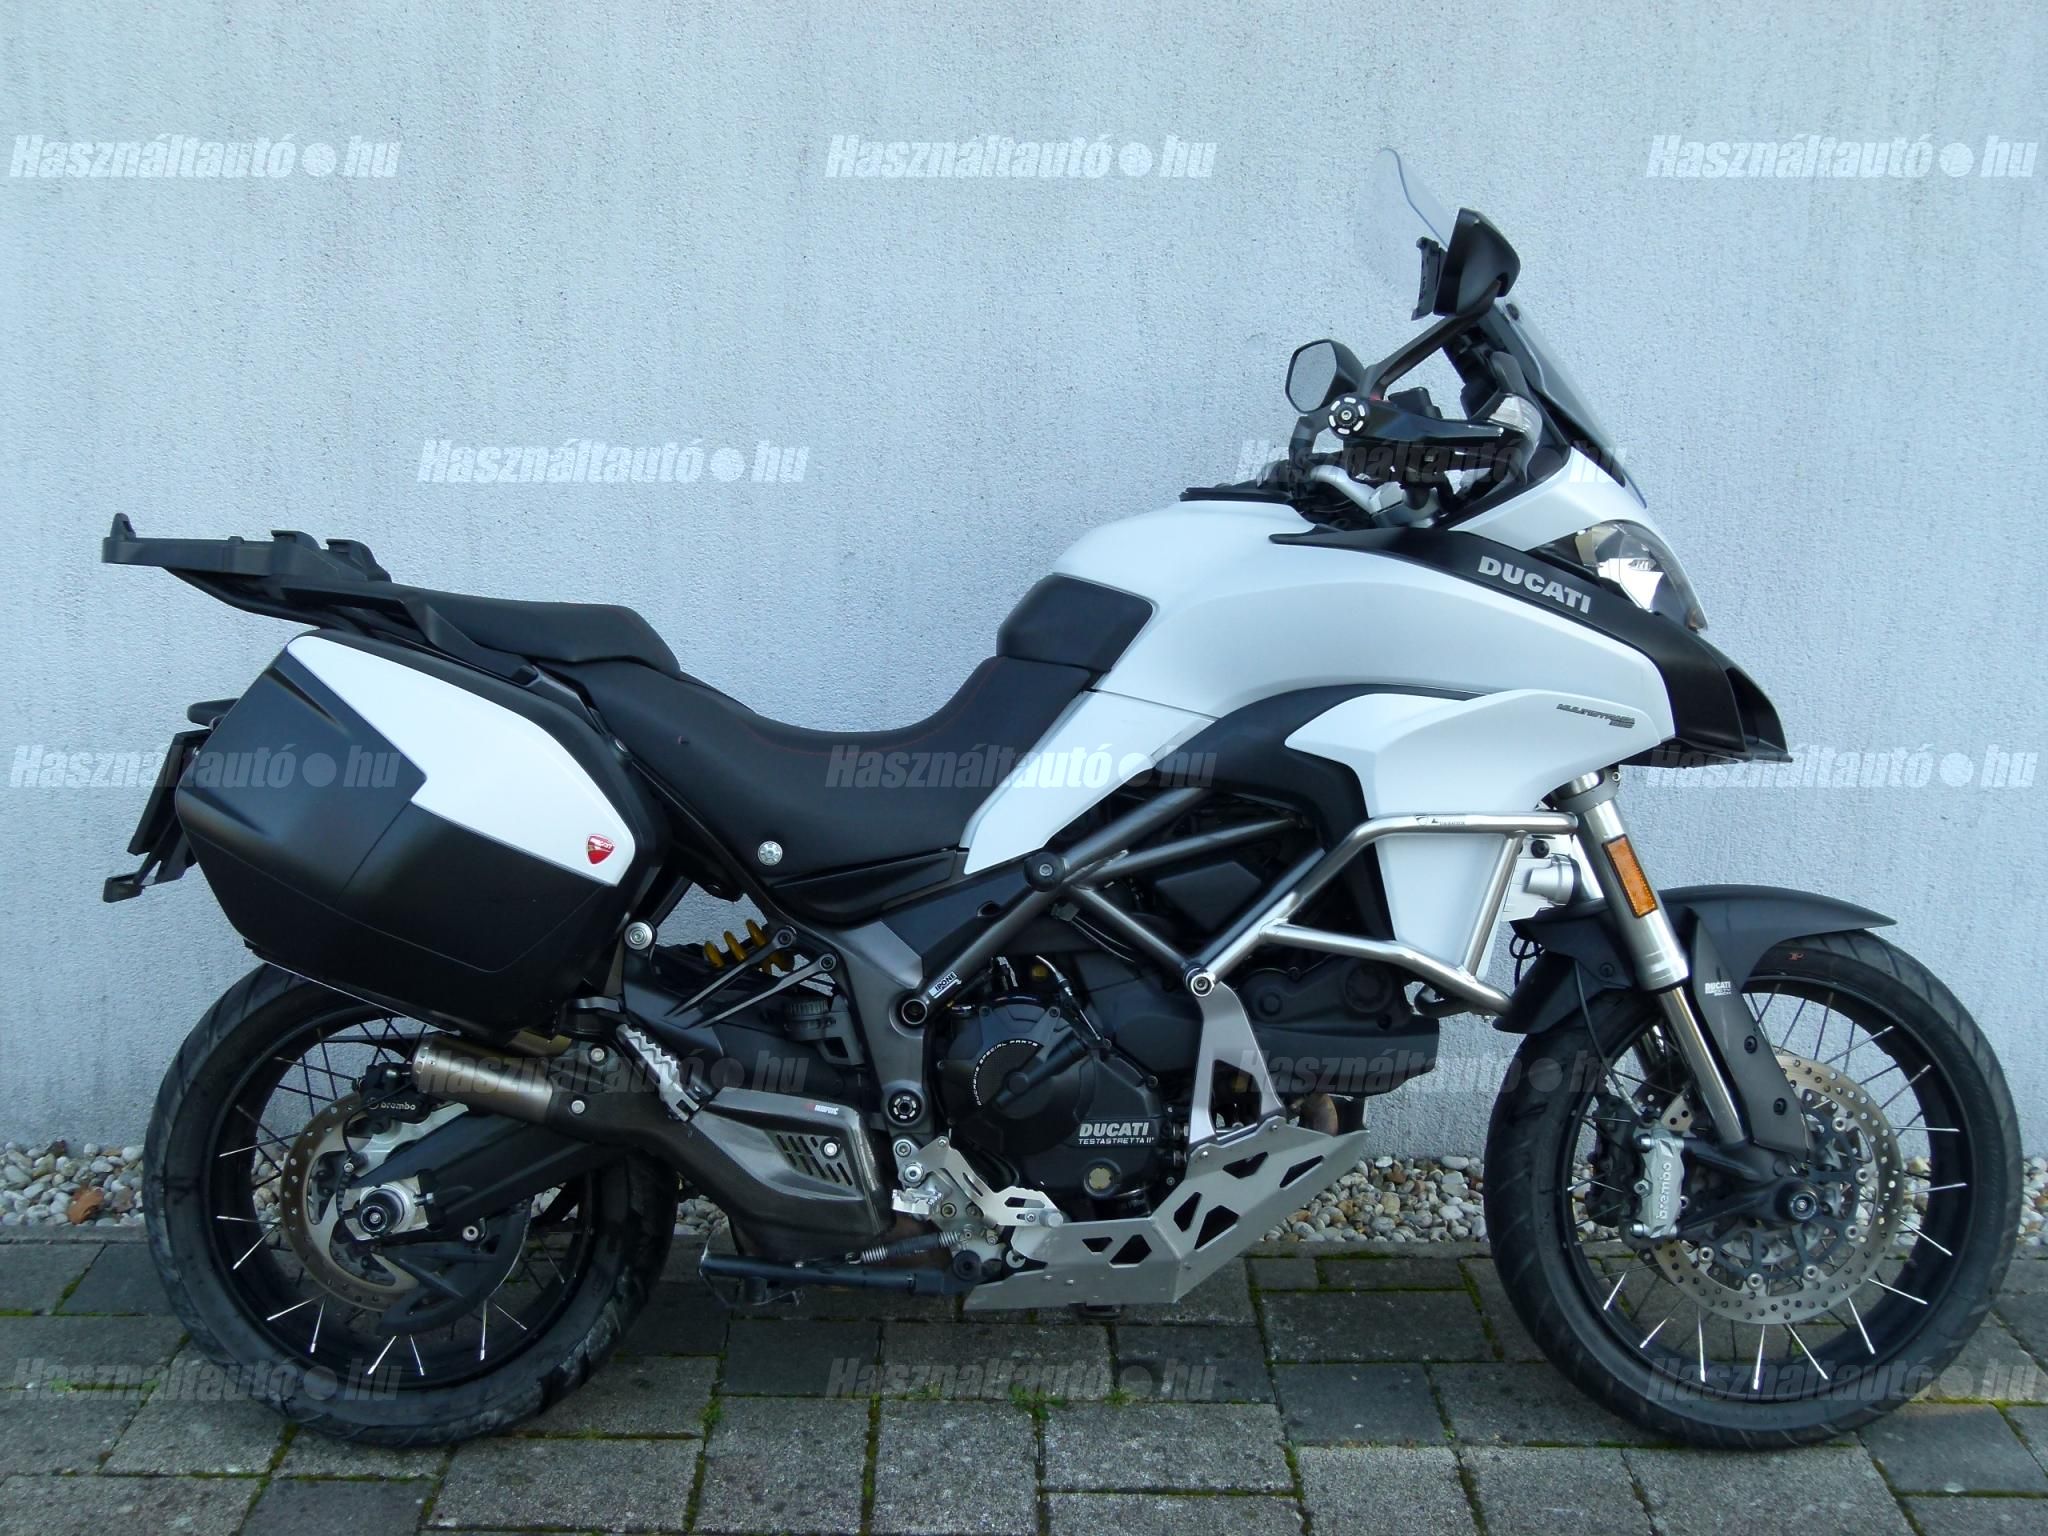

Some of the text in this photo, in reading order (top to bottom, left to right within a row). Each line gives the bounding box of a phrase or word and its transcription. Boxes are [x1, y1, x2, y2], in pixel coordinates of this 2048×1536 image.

[1478, 555, 1591, 614] DUCATI
[934, 972, 957, 992] IPONE
[380, 1101, 417, 1111] brembo
[1079, 1122, 1150, 1137] DUCATI
[1655, 1162, 1672, 1220] brembo
